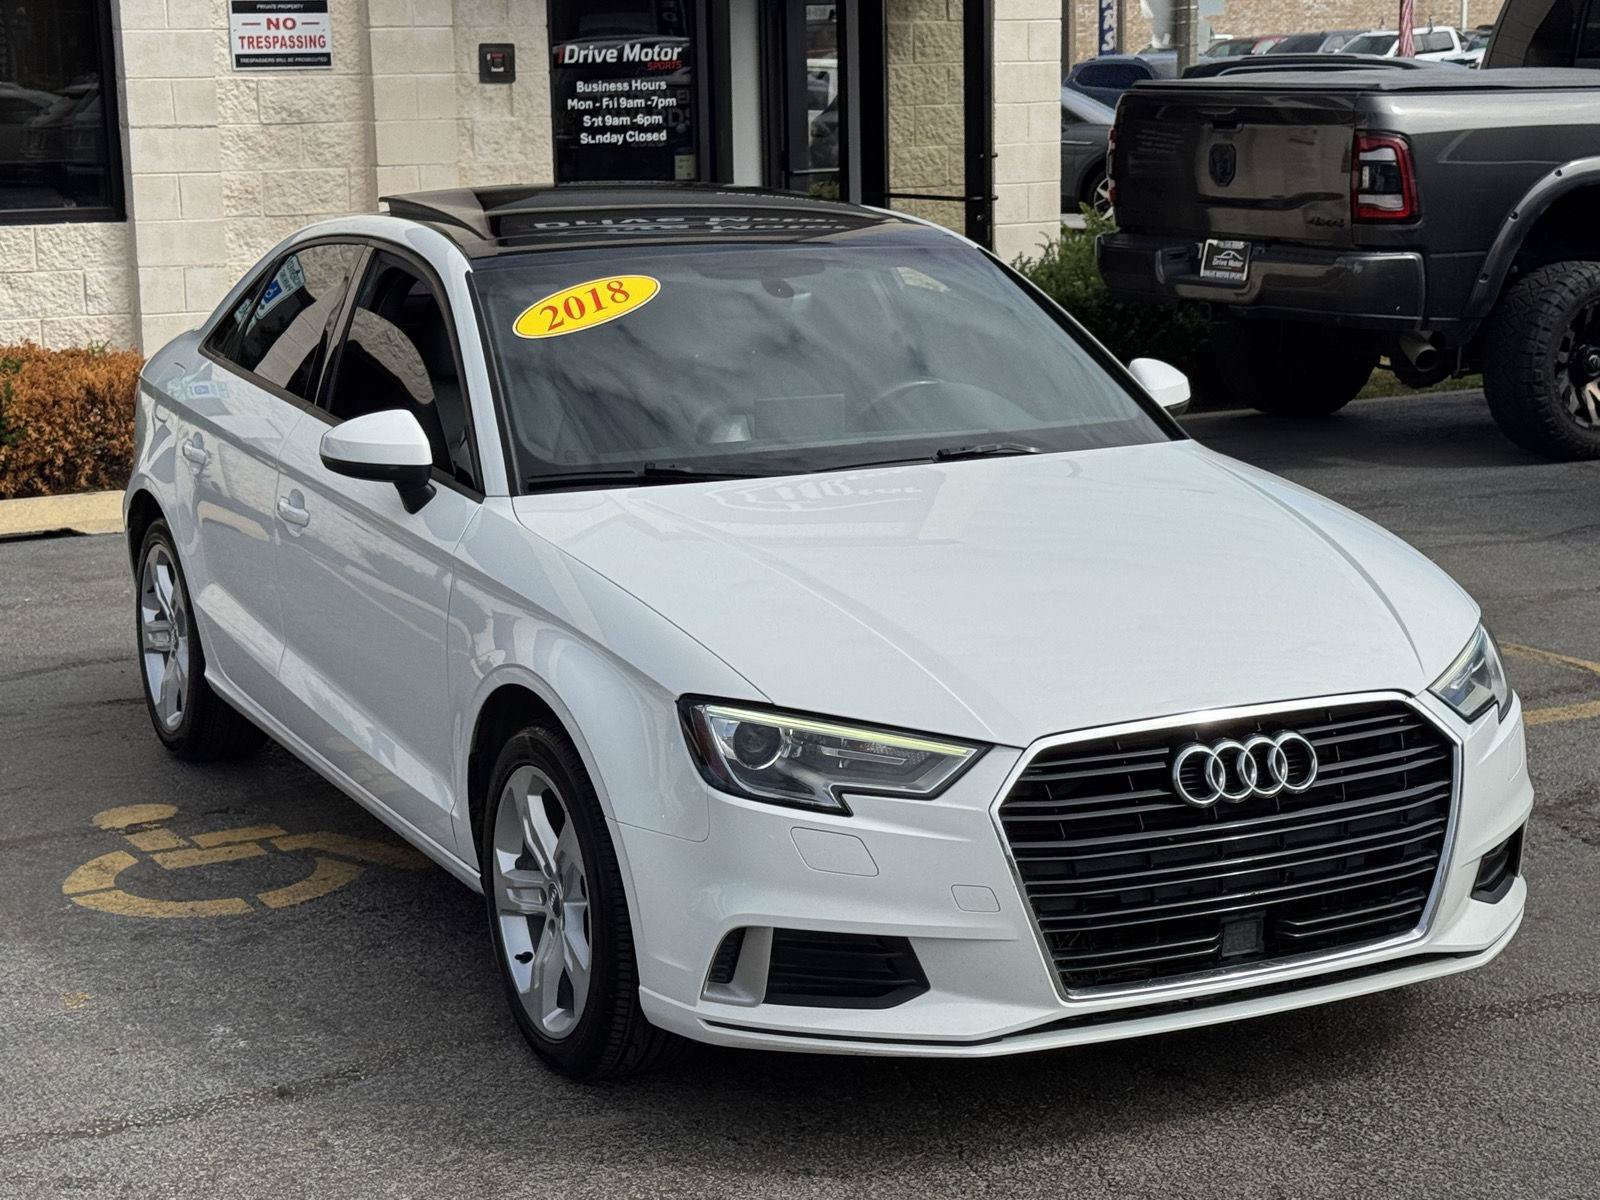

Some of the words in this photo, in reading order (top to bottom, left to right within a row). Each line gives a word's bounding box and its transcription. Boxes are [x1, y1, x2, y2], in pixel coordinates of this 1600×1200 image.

[266, 17, 296, 30] NO
[238, 34, 326, 49] TRESPASSING
[623, 43, 682, 62] Motor
[647, 61, 682, 71] SPORTS
[576, 81, 629, 93] Business
[631, 80, 667, 91] Hours
[567, 98, 593, 110] Mon
[619, 97, 645, 109] 9am
[604, 115, 630, 126] 9am
[626, 129, 667, 142] Closed
[540, 280, 630, 331] 2018
